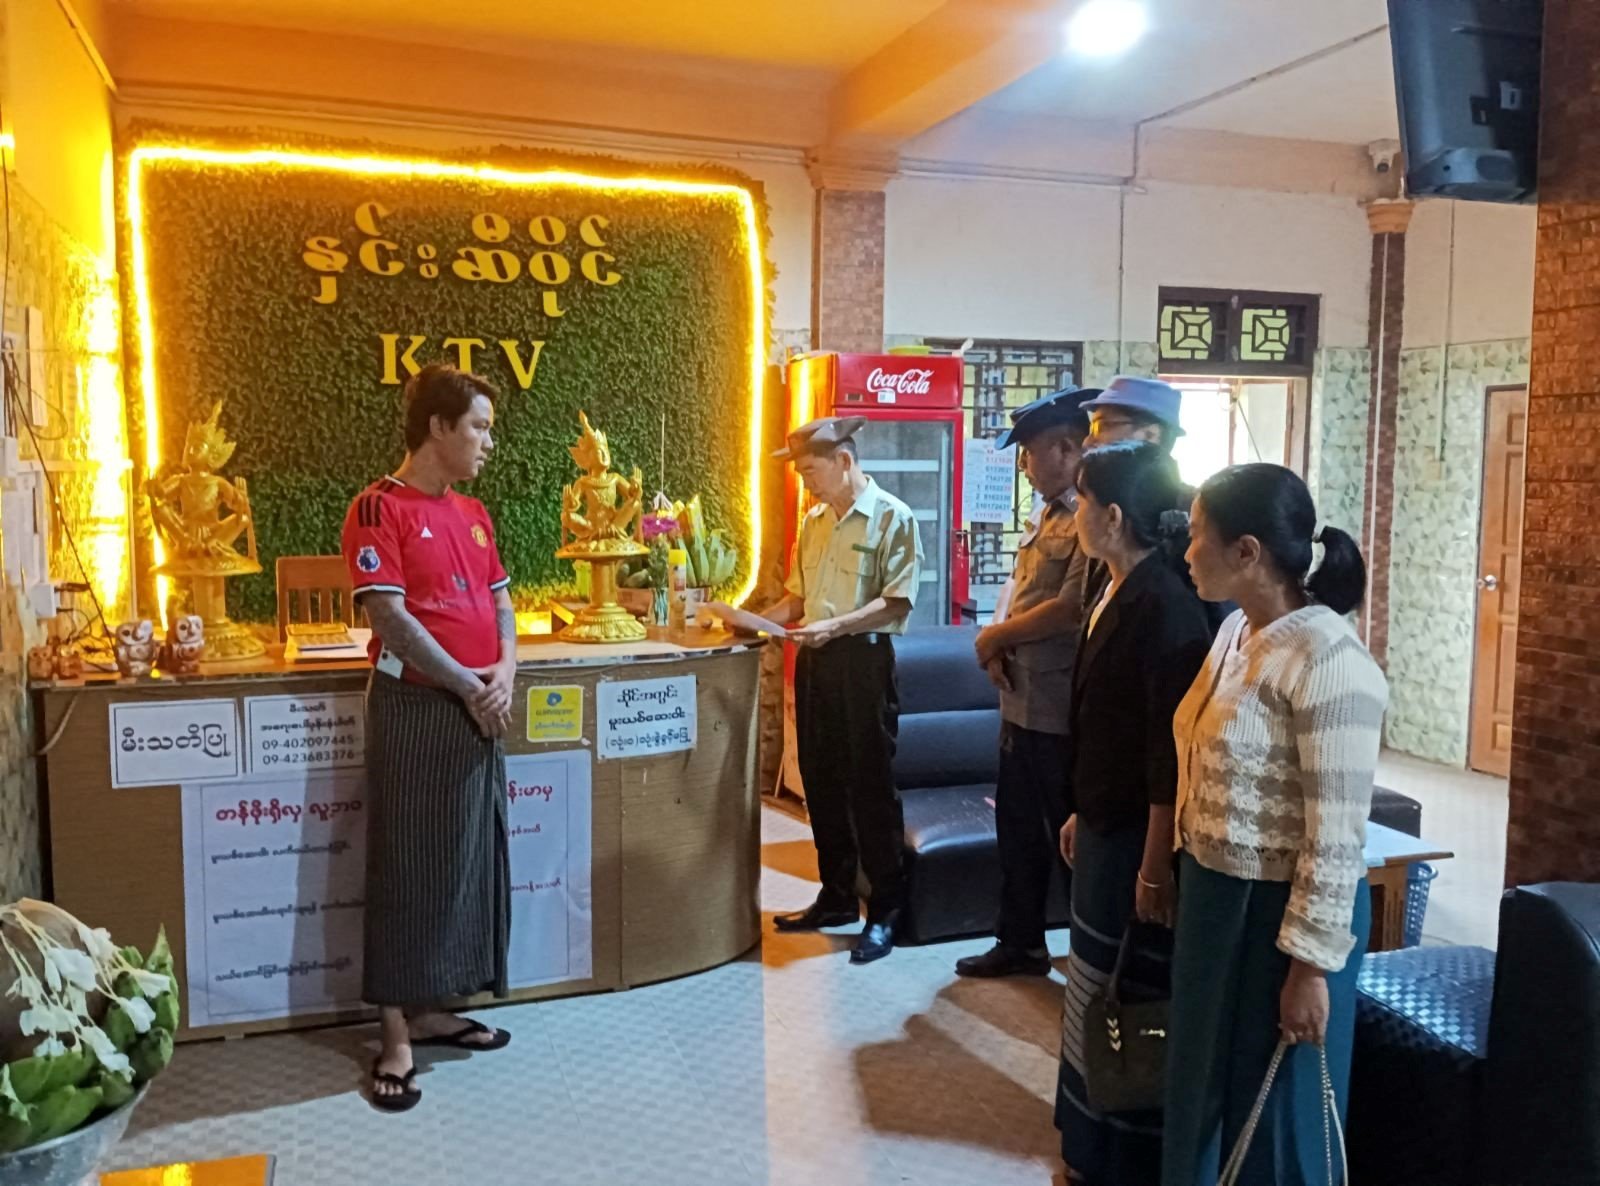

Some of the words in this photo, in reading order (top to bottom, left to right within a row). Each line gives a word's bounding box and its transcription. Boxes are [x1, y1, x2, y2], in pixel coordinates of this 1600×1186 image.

[378, 333, 545, 390] KTV
[866, 367, 935, 395] Coca-Cola
[121, 723, 231, 758] မီးသတိပြု
